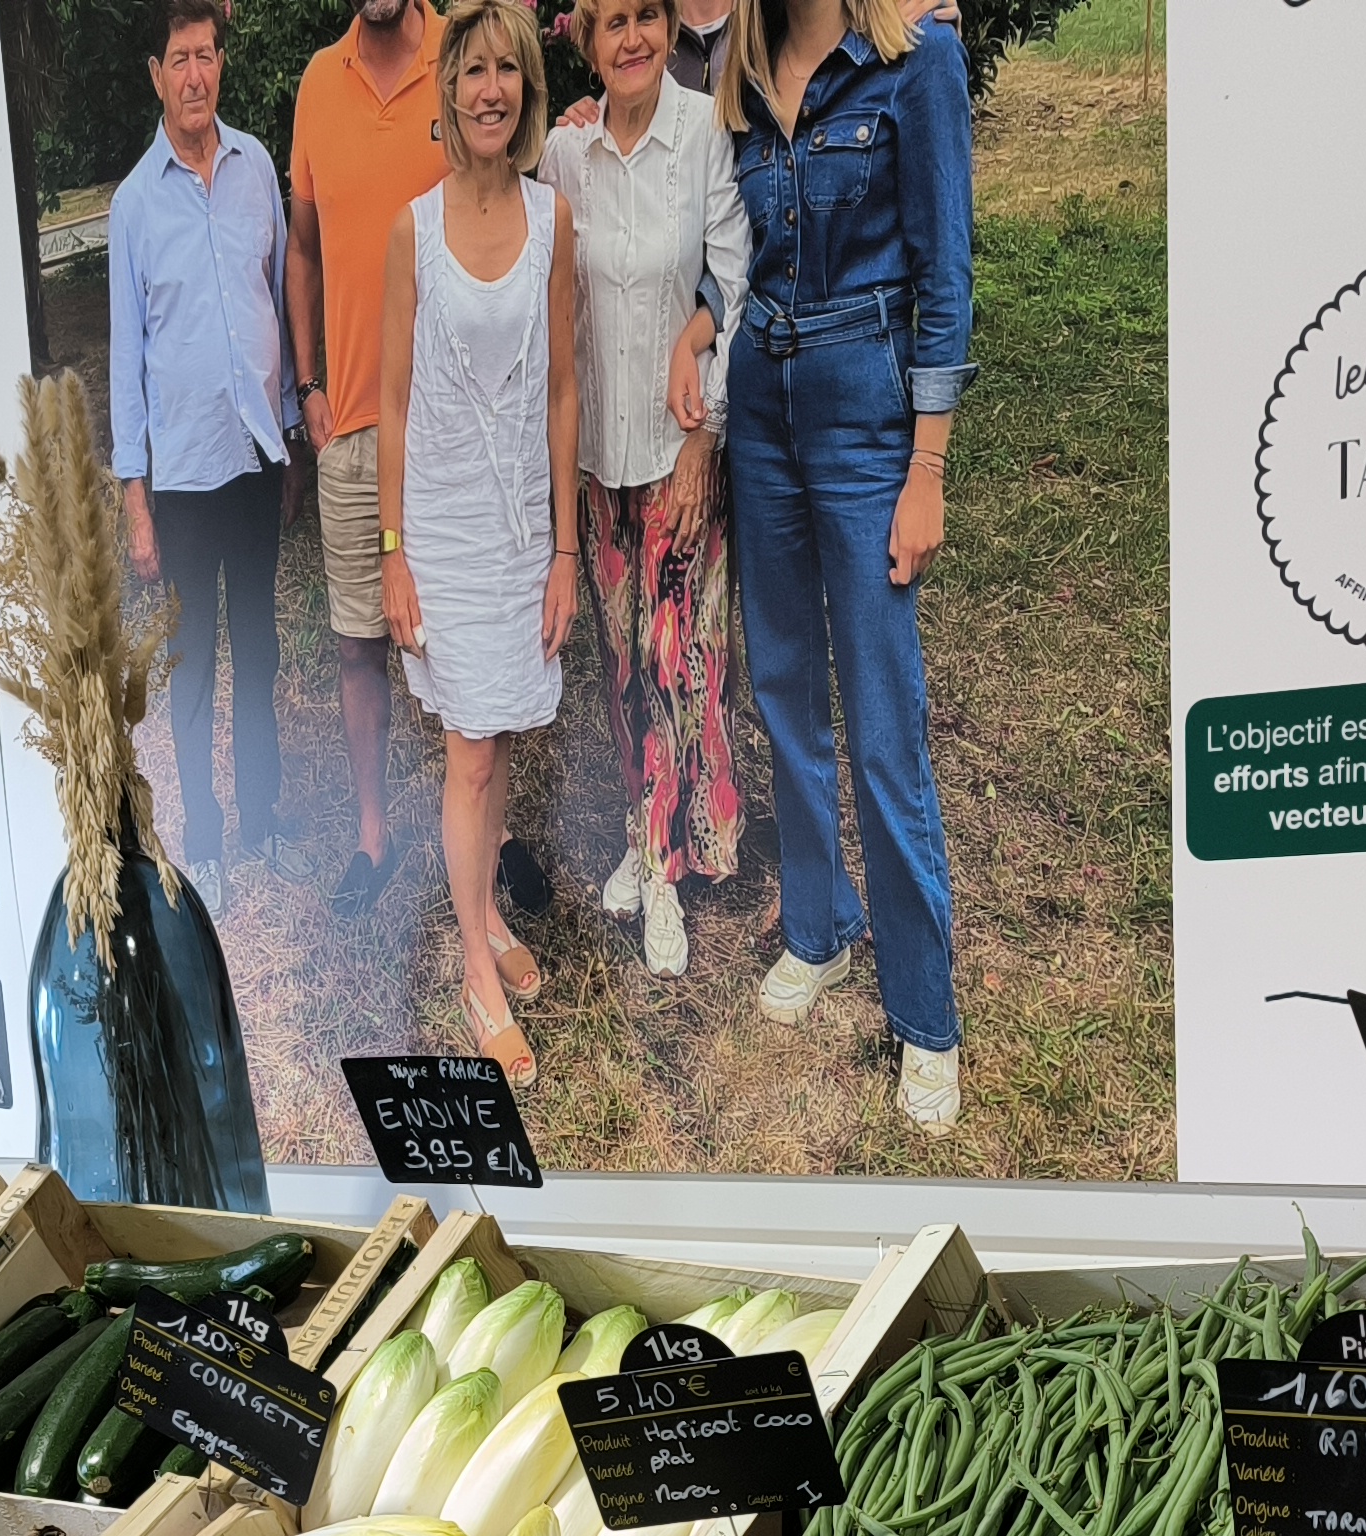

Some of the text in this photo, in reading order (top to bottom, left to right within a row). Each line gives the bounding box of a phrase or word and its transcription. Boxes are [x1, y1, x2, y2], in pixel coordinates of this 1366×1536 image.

[1214, 762, 1308, 793] efforts
[438, 1058, 499, 1083] FRANCE
[403, 1138, 473, 1175] 3,95
[227, 1299, 271, 1343] 1kg
[643, 1330, 704, 1363] 1kg
[188, 1362, 323, 1448] COURGETTE
[596, 1375, 675, 1416] 5,40
[579, 1434, 632, 1454] Produit
[1227, 1425, 1291, 1449] Produit
[599, 1494, 646, 1512] Origine
[1236, 1496, 1291, 1524] Origine
